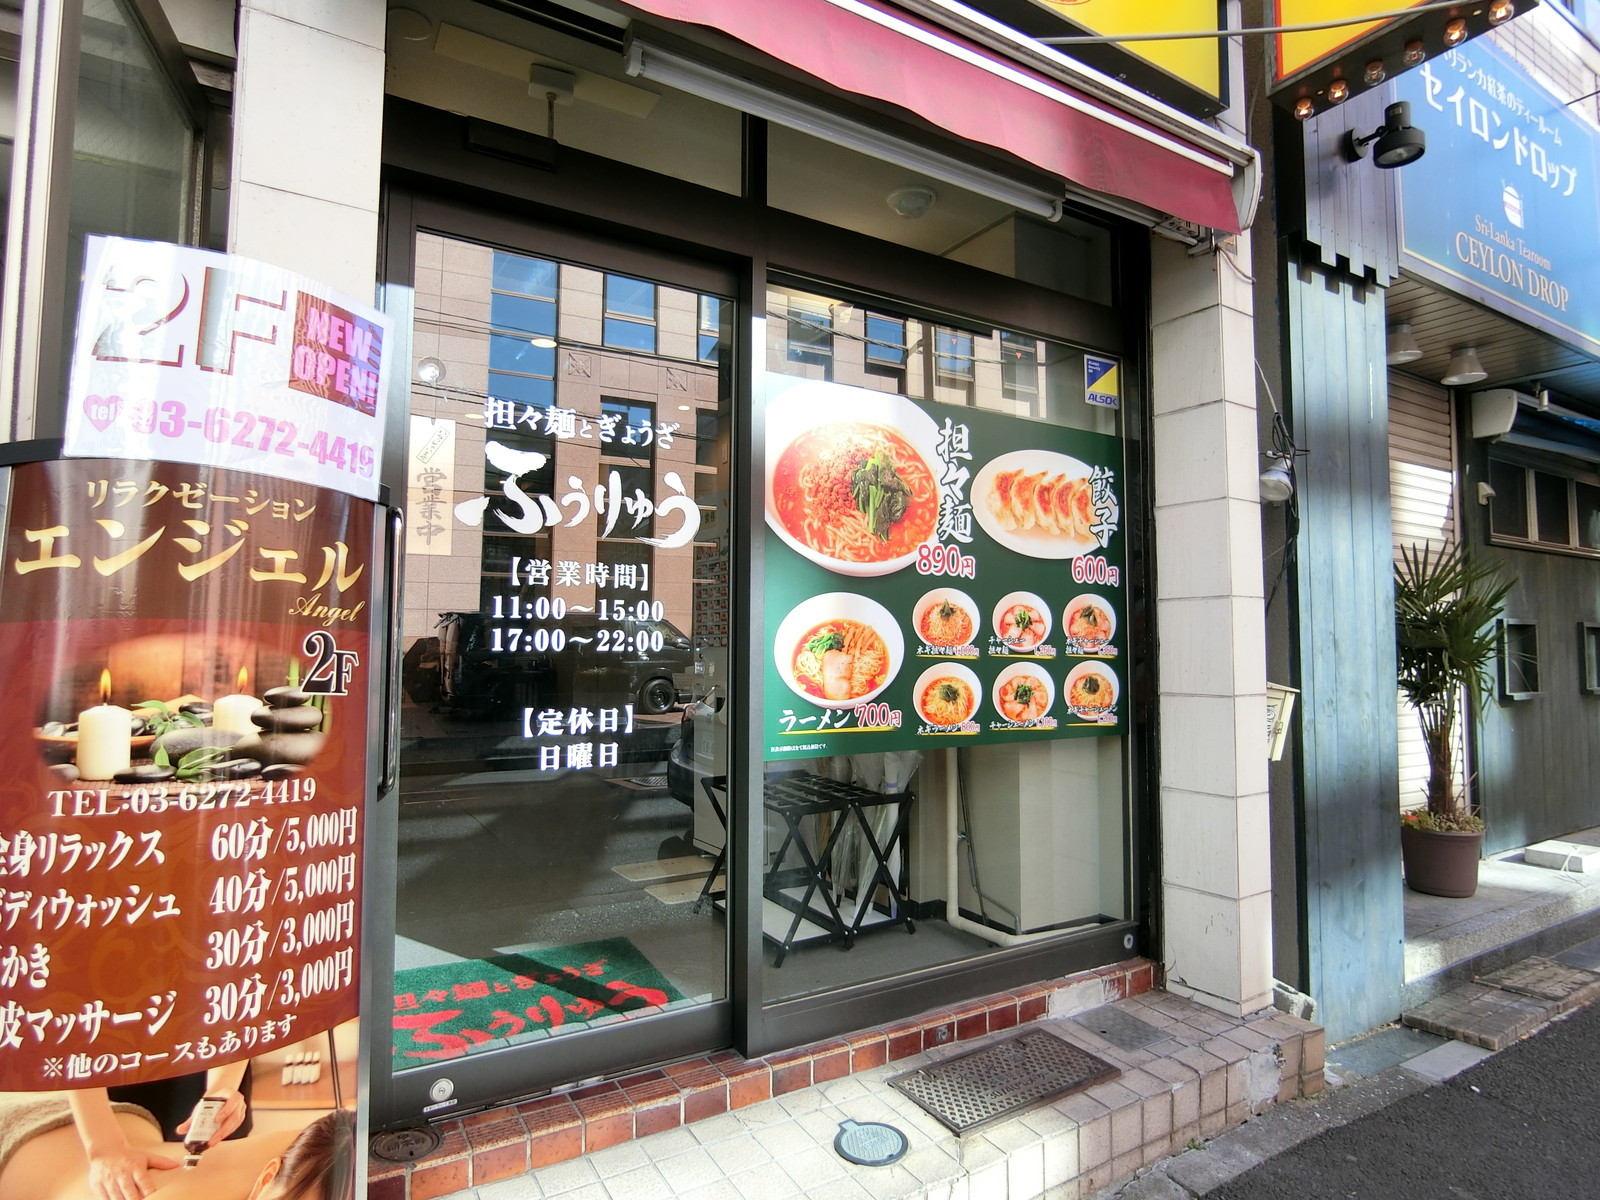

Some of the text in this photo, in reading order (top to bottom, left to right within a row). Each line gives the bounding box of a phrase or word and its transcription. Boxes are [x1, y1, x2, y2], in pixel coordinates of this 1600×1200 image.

[1420, 62, 1577, 196] セイロンドロップ
[1475, 214, 1551, 271] Sri-Lanka Tearoom
[1455, 231, 1569, 312] CEYLON DROP
[92, 266, 287, 376] 2F
[307, 306, 372, 363] NEW
[484, 397, 681, 450] 担々麺とぎょうざ
[1088, 393, 1117, 406] ALSOK
[86, 479, 317, 522] リラクゼーション
[416, 466, 448, 546] 営業中
[454, 440, 701, 549] ふうりゅう
[936, 417, 975, 544] 担々麺
[1088, 465, 1119, 549] 餃子
[15, 519, 364, 593] エンジェル
[509, 556, 650, 591] 【営業時間】
[916, 544, 976, 579] 890円
[1072, 556, 1120, 587] 600円
[288, 593, 366, 627] Angel
[301, 630, 359, 696] 2F
[522, 703, 635, 738] 【定休日】
[778, 703, 903, 733] ラーメン 700円
[538, 741, 620, 772] 日曜日
[48, 777, 317, 817] TEL:03-6272-4419
[43, 1014, 298, 1080] ※他のコースもあります
